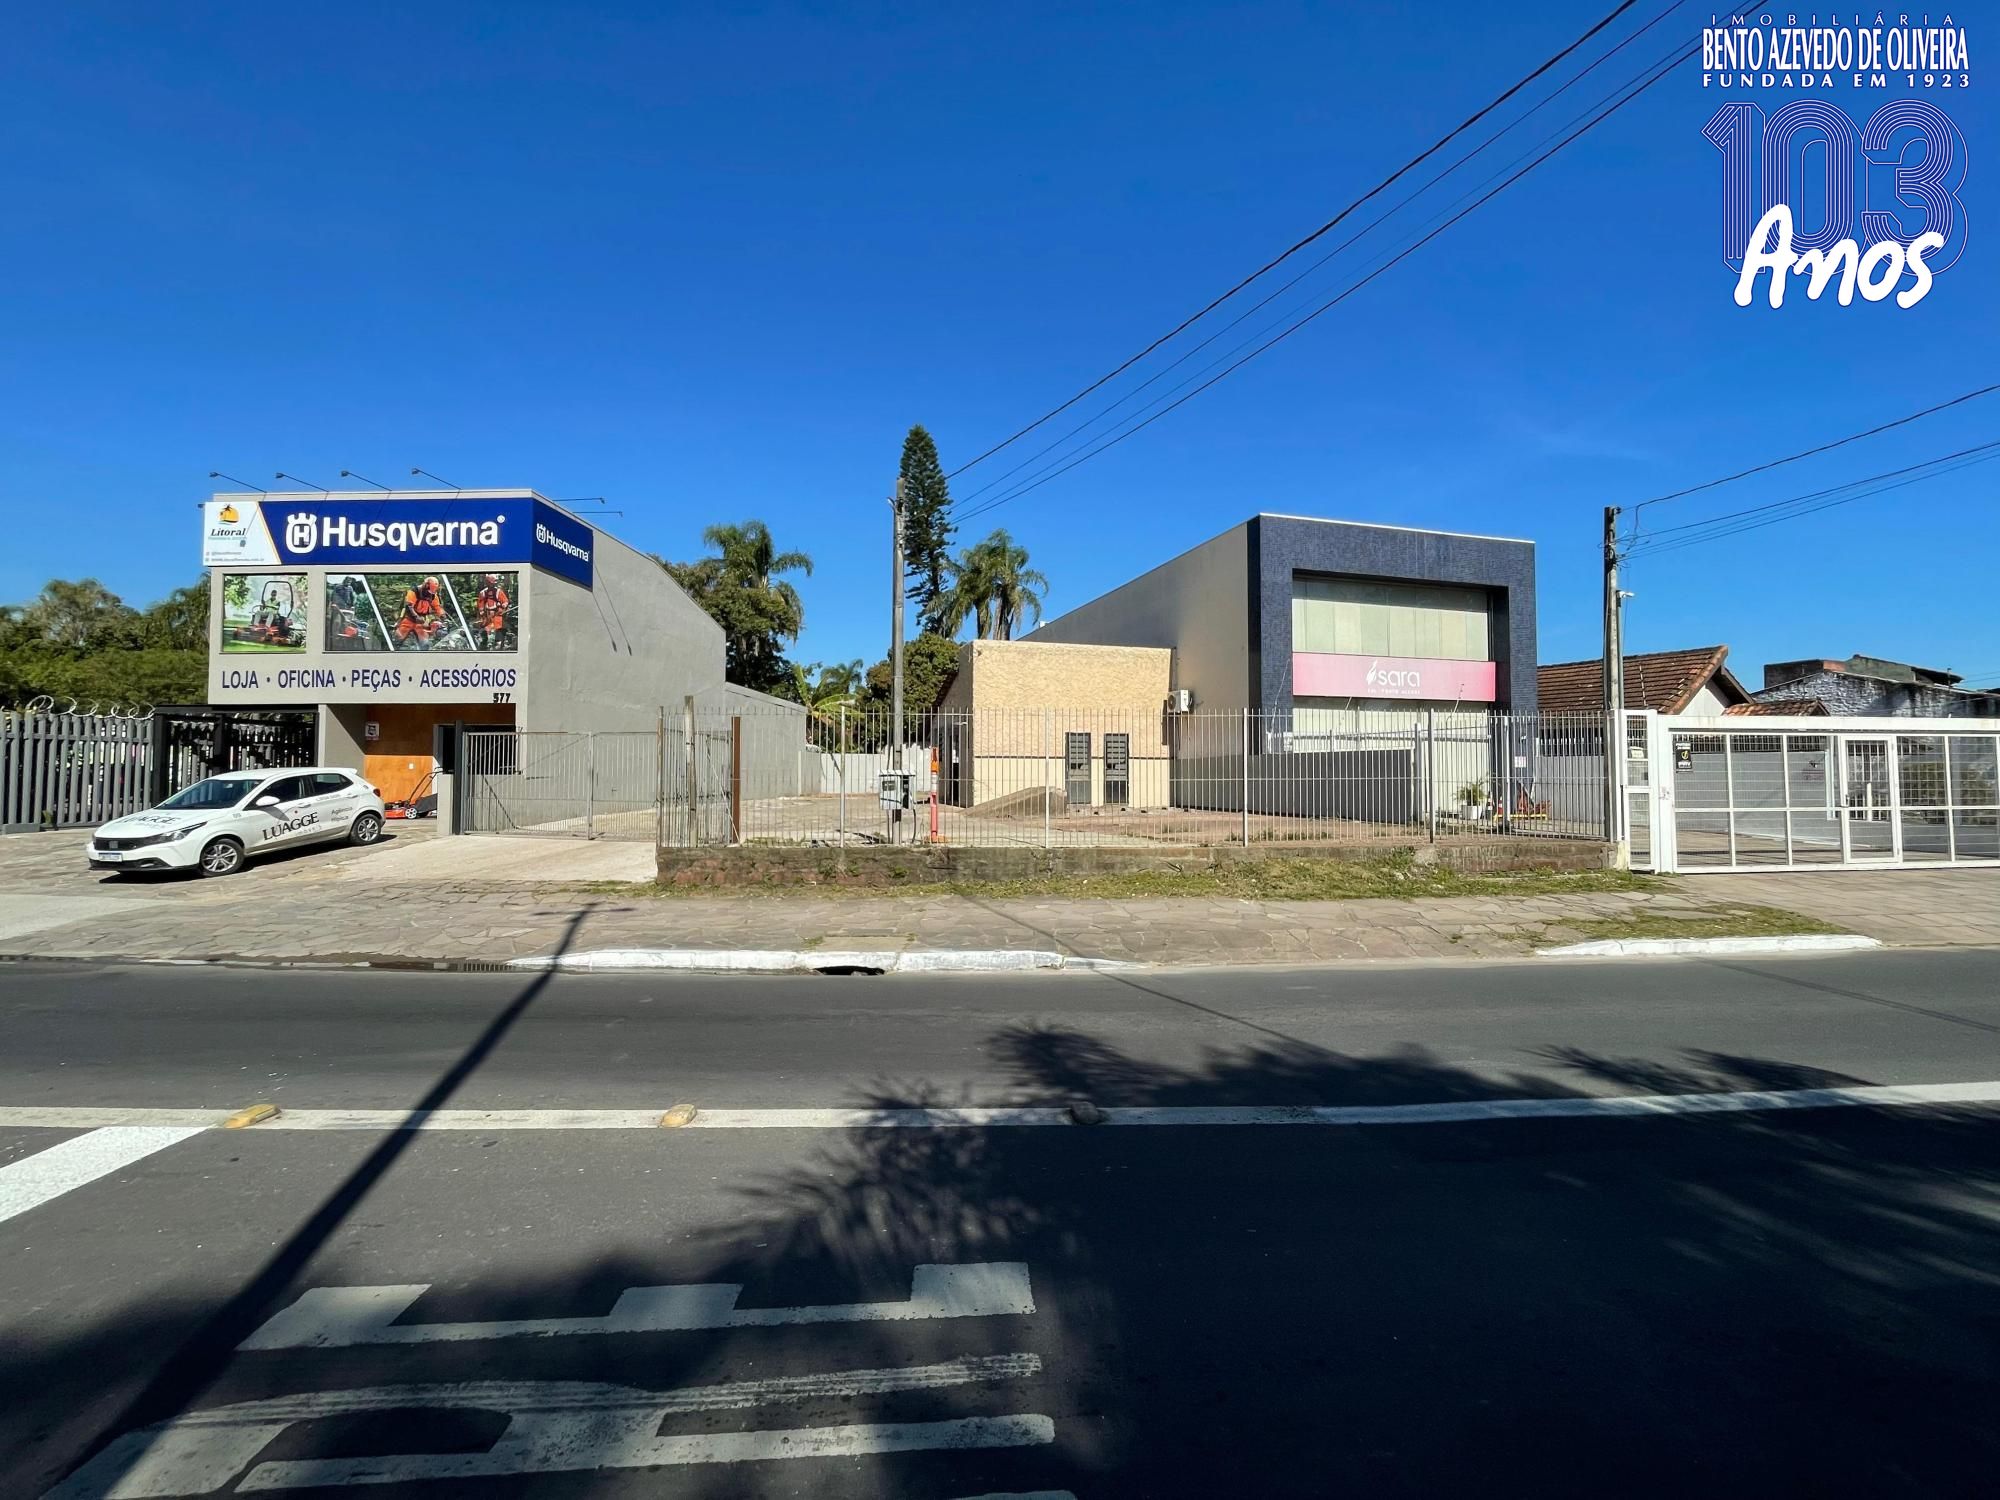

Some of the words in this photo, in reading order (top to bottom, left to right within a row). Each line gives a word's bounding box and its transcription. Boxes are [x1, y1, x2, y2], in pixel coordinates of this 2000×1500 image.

[210, 528, 247, 537] Litoral
[322, 516, 499, 552] Husqvarna
[546, 529, 590, 562] Husqvarna
[221, 670, 259, 690] LOJA
[277, 669, 336, 689] OFICINA
[351, 668, 402, 692] PEÇAS
[420, 664, 517, 688] ACESSÓRIOS
[1377, 670, 1421, 688] sara
[262, 812, 320, 841] LUAGGE
